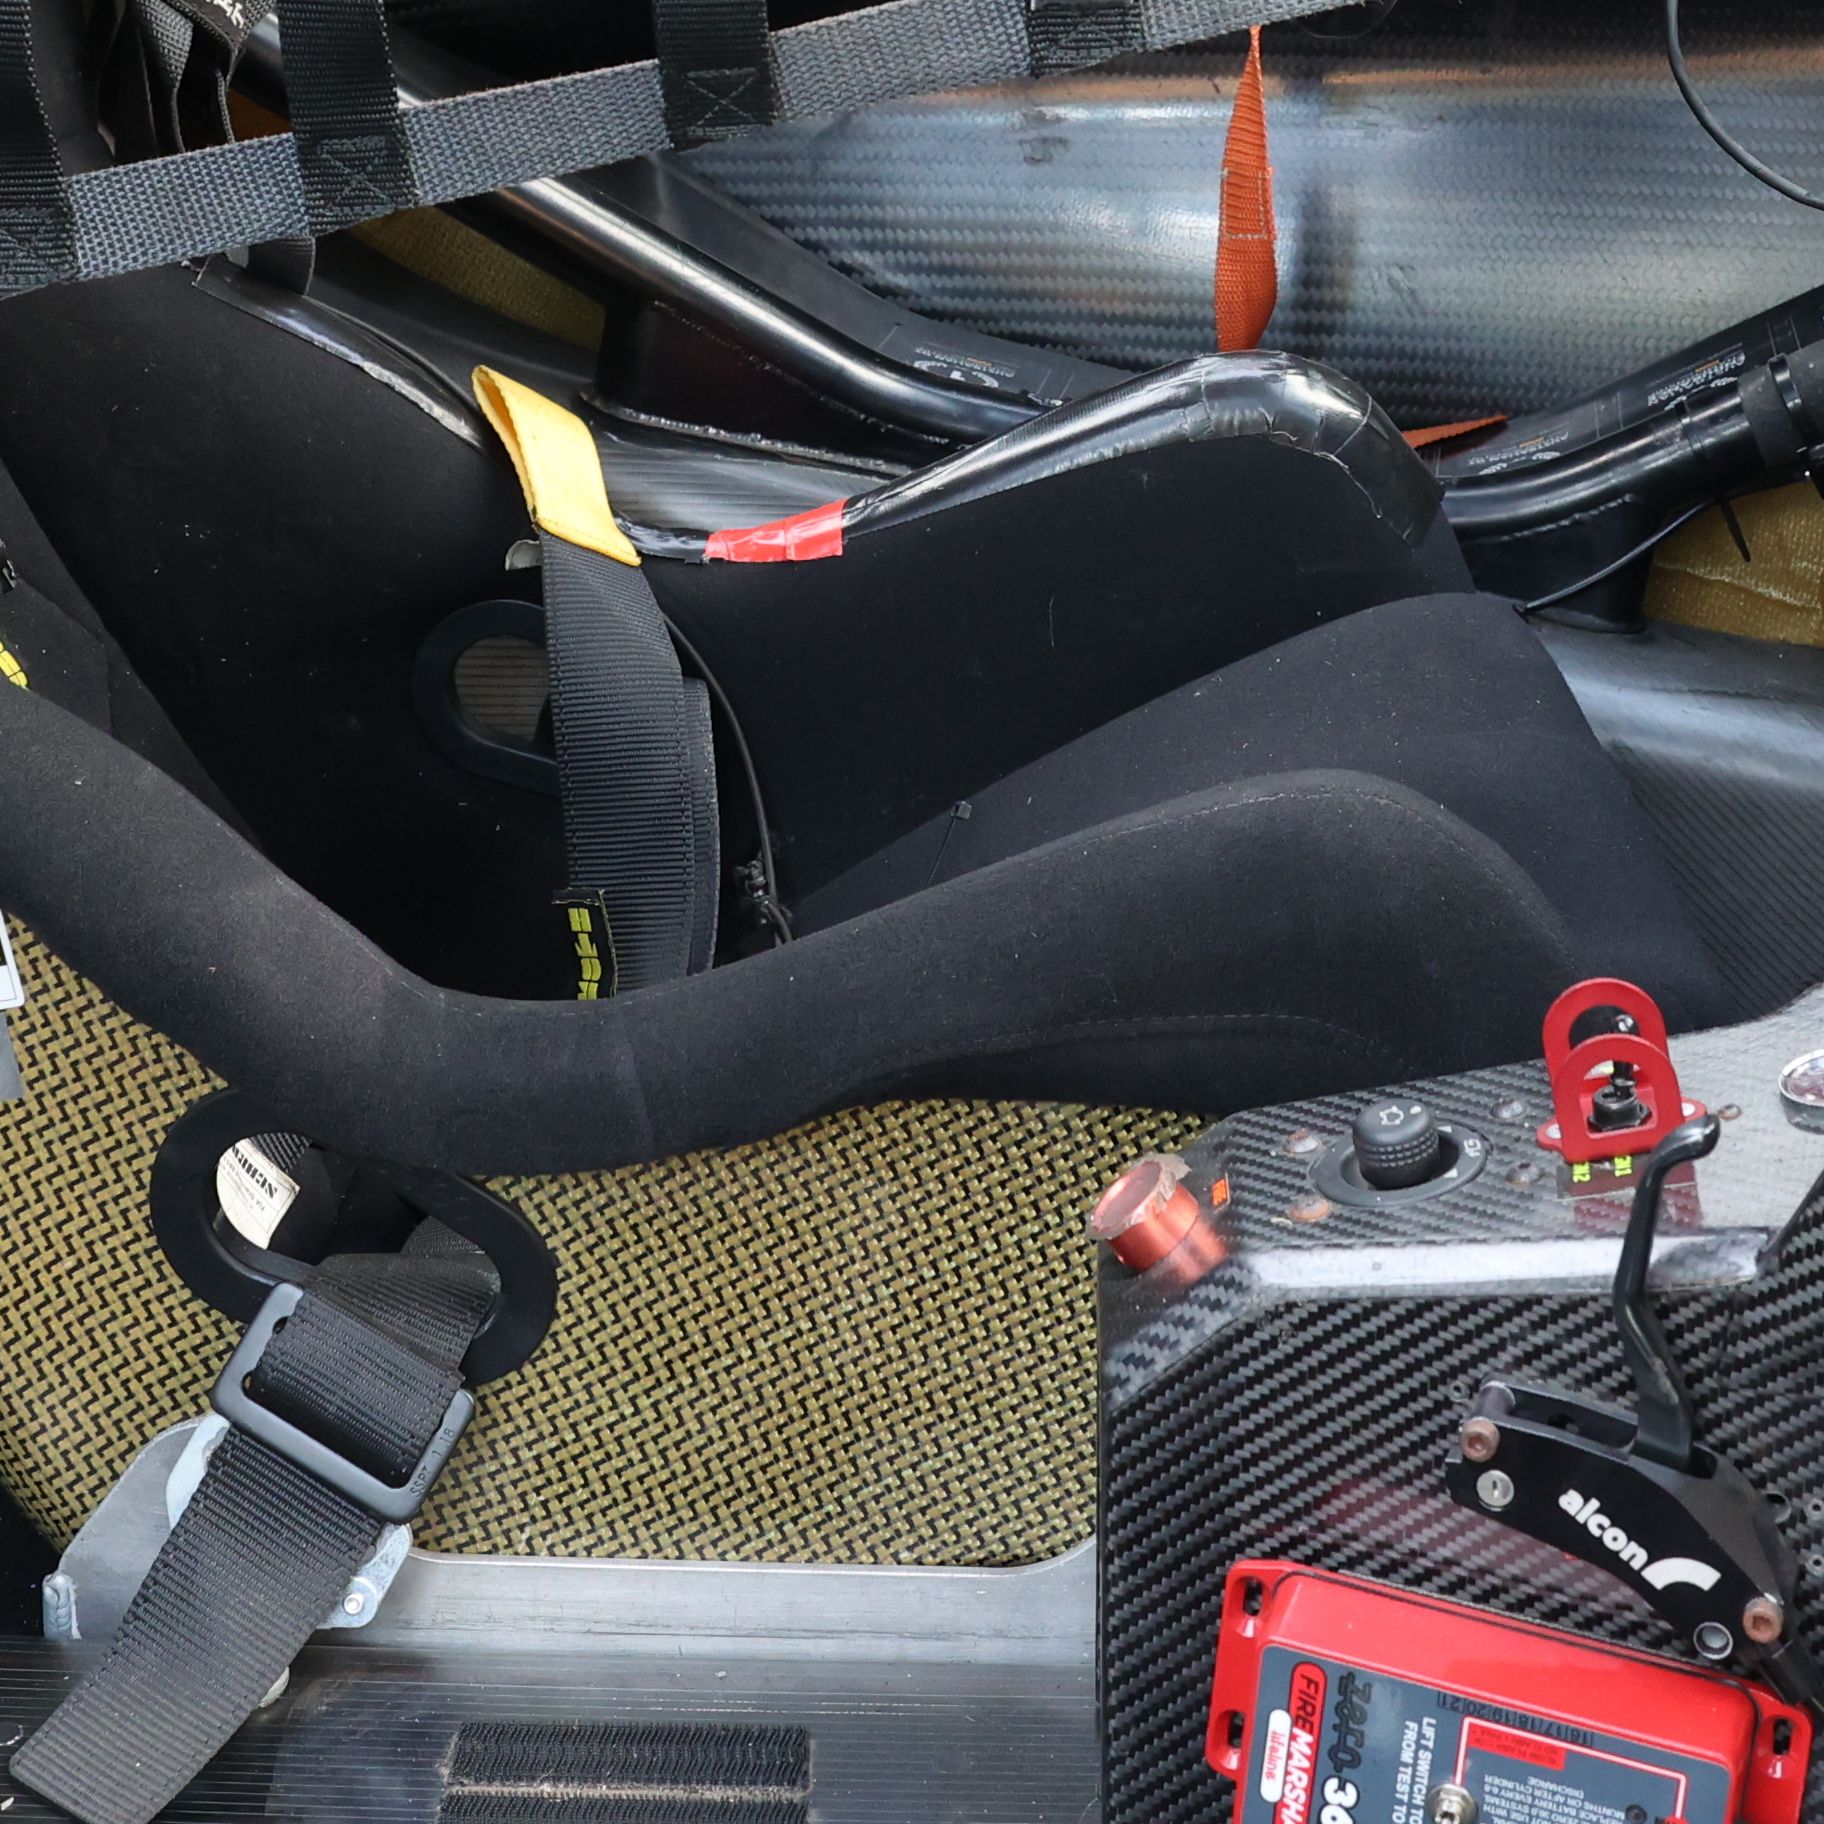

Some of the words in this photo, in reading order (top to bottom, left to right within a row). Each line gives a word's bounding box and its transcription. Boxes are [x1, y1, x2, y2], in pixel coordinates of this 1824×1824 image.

[1558, 1489, 1648, 1571] alcon
[1399, 1720, 1418, 1764] FROM
[1421, 1716, 1437, 1749] LIFT
[1395, 1766, 1412, 1802] TEST
[1412, 1750, 1433, 1806] SWITCH
[1484, 1774, 1533, 1794] CYLINDER
[1527, 1776, 1584, 1800] DISCHARGE
[1499, 1789, 1532, 1804] EVERY
[1533, 1788, 1566, 1804] AFTER
[1533, 1798, 1577, 1816] BATTERY
[1483, 1803, 1507, 1818] WITH
[1583, 1801, 1625, 1820] MONTHS
